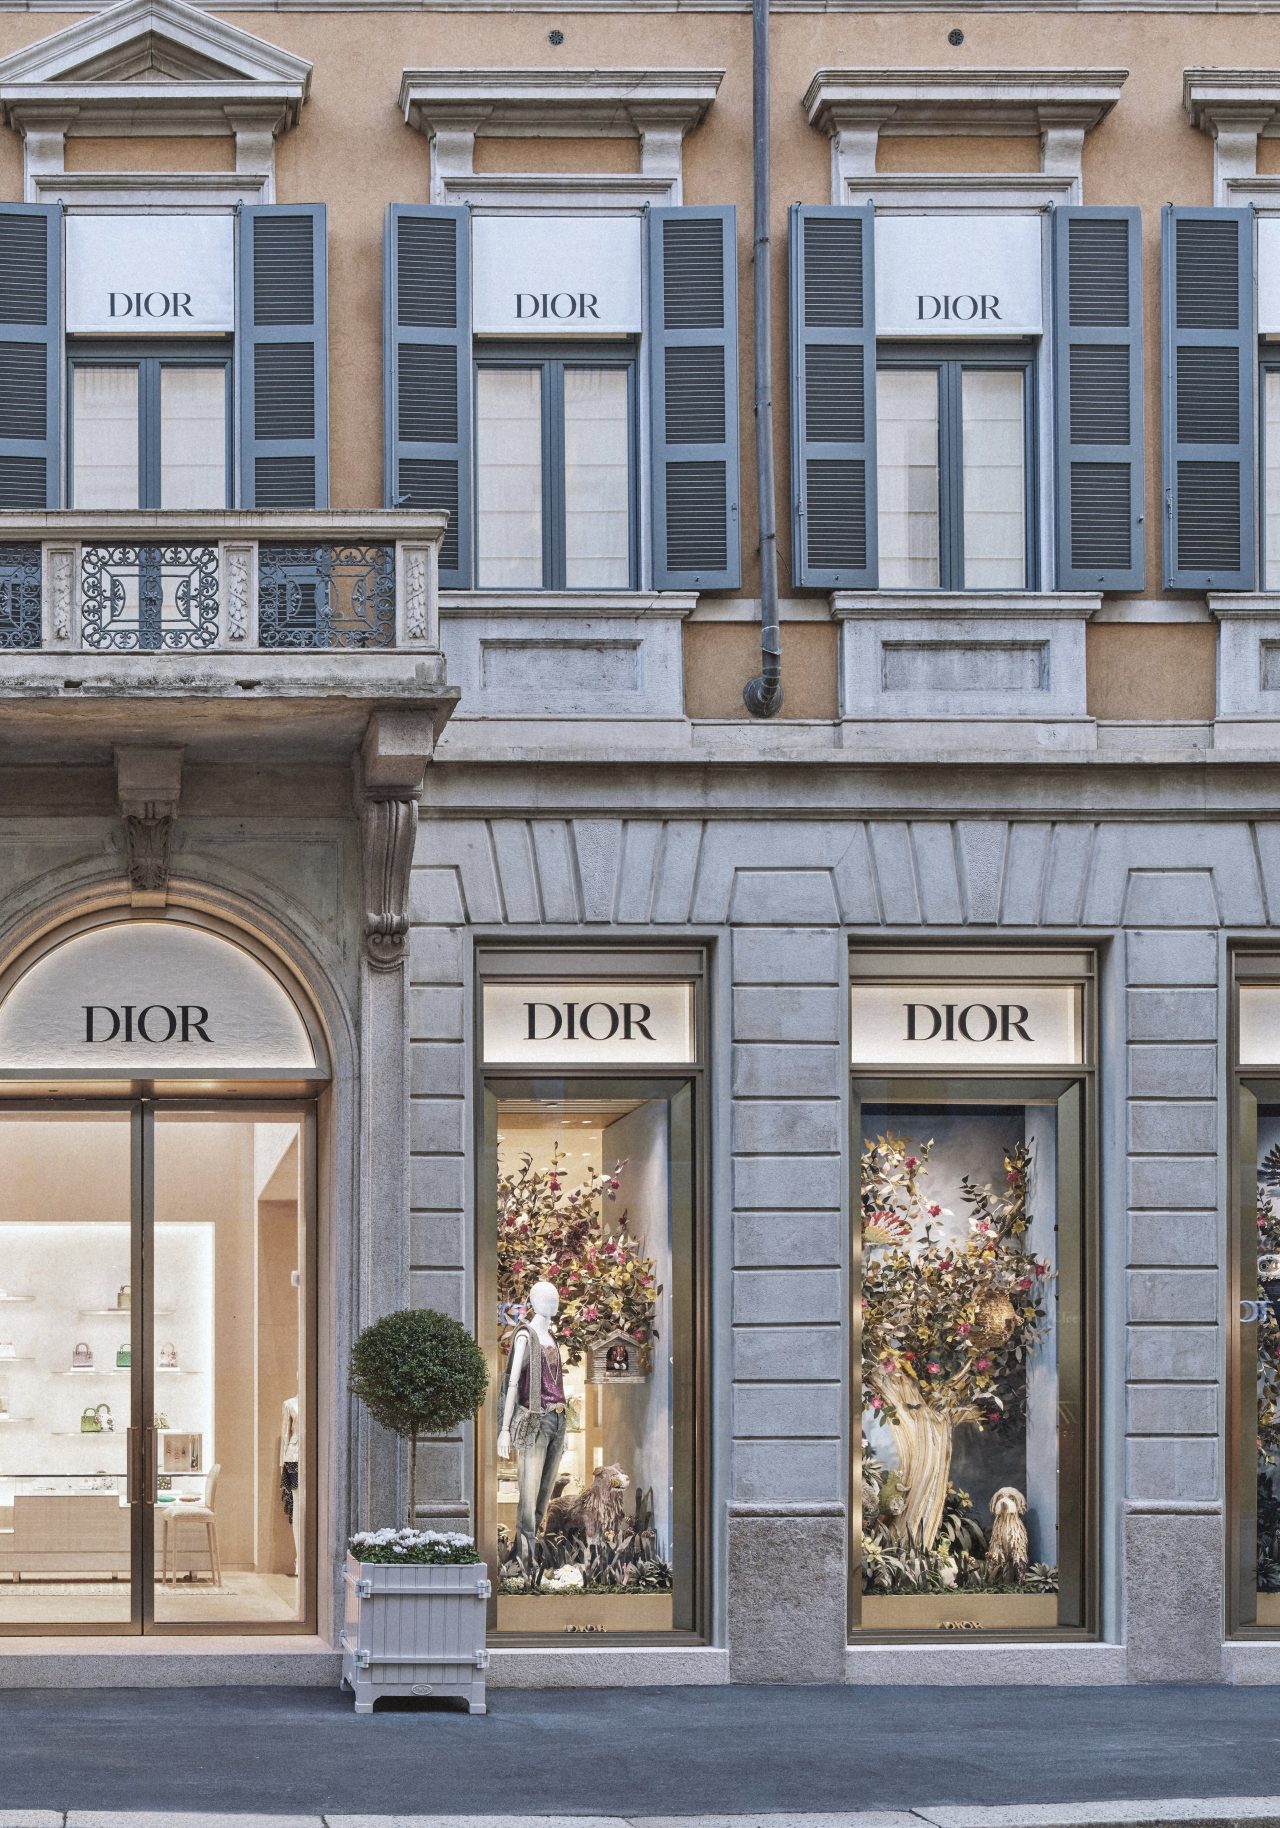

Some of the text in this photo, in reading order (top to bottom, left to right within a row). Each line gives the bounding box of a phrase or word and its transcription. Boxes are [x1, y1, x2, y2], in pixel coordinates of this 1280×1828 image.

[109, 293, 193, 318] DIOR
[516, 294, 600, 318] DIOR
[918, 295, 1002, 319] DIOR
[82, 1005, 214, 1042] DIOR
[524, 1003, 656, 1040] DIOR
[904, 1004, 1035, 1041] DIOR
